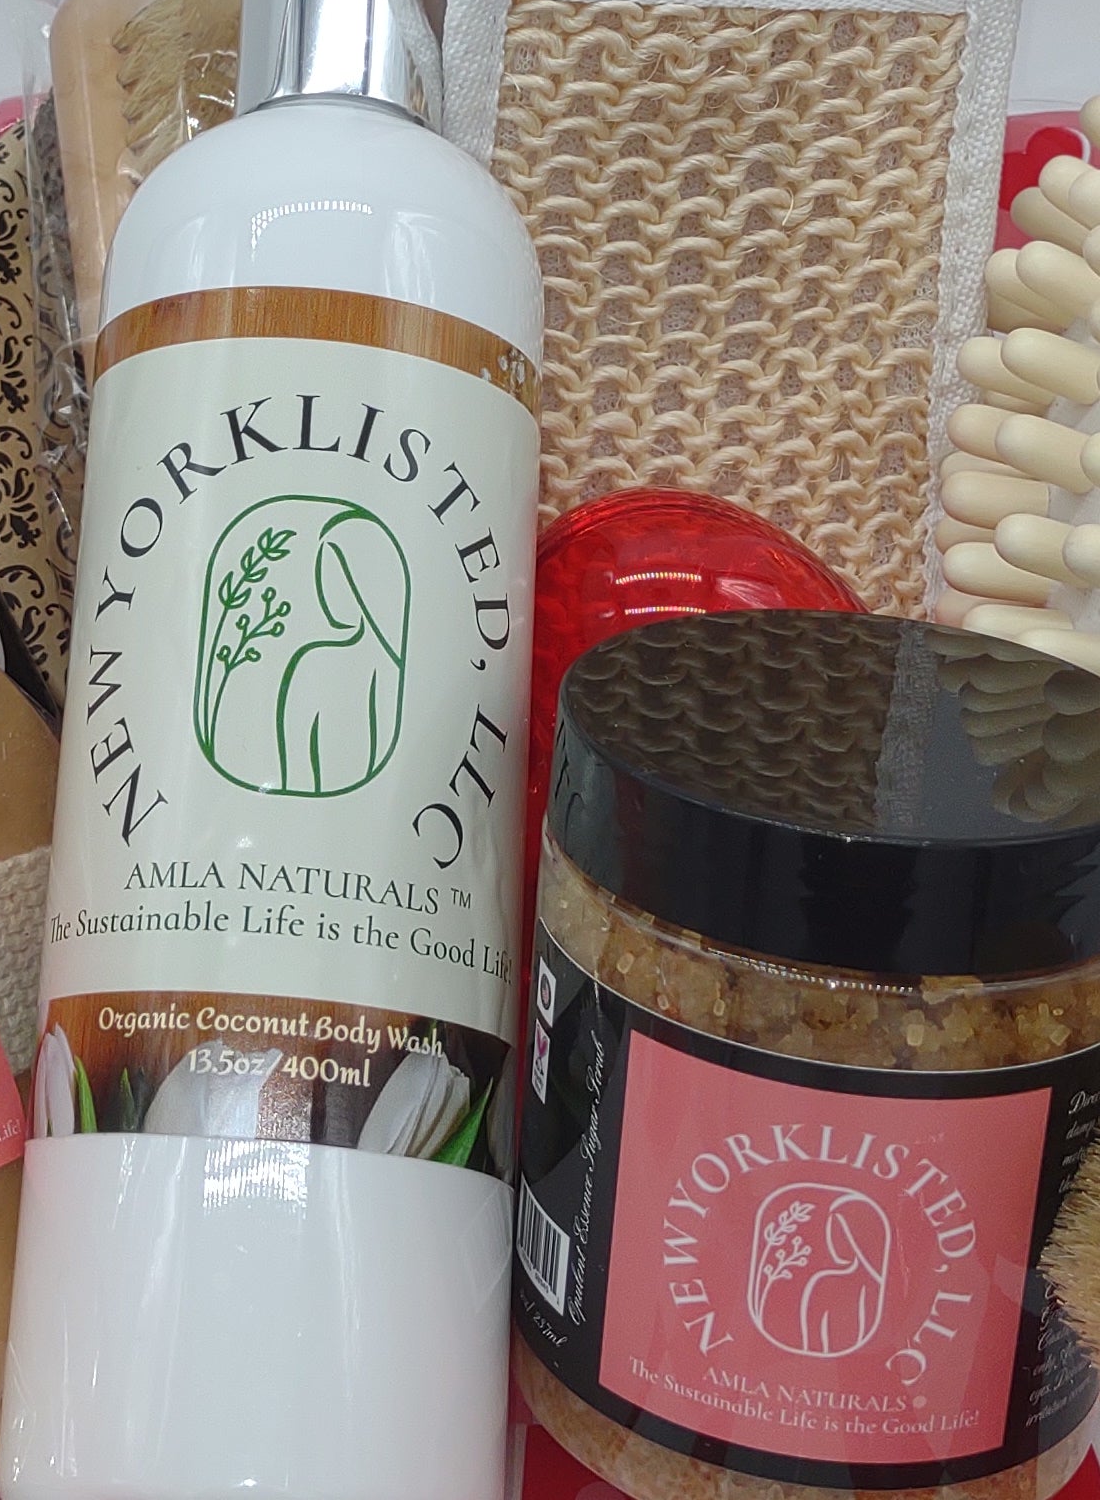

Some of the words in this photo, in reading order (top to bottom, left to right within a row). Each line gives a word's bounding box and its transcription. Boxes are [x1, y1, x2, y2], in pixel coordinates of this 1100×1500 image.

[412, 702, 509, 870] LLC
[124, 861, 224, 891] AMLA
[238, 865, 440, 915] NATURALS
[50, 915, 72, 944] The
[76, 900, 230, 938] Sustainable
[242, 903, 305, 937] Life
[317, 914, 341, 941] is
[353, 914, 400, 950] the
[411, 926, 475, 968] Good
[98, 1002, 191, 1036] Organic
[196, 1007, 313, 1038] Coconut
[314, 1016, 381, 1053] Body
[387, 1023, 444, 1058] Wash
[586, 1029, 605, 1105] Scrub
[580, 1103, 602, 1173] Sugar
[573, 1172, 594, 1245] Essence
[885, 1292, 971, 1387] LLC
[630, 1356, 659, 1384] The
[663, 1373, 774, 1423] Sustainable
[780, 1407, 819, 1431] Life
[824, 1414, 839, 1432] is
[846, 1415, 877, 1435] the
[882, 1414, 935, 1435] Good
[940, 1409, 980, 1432] Life!
[701, 1366, 771, 1399] AMLA
[777, 1385, 907, 1413] NATURALS
